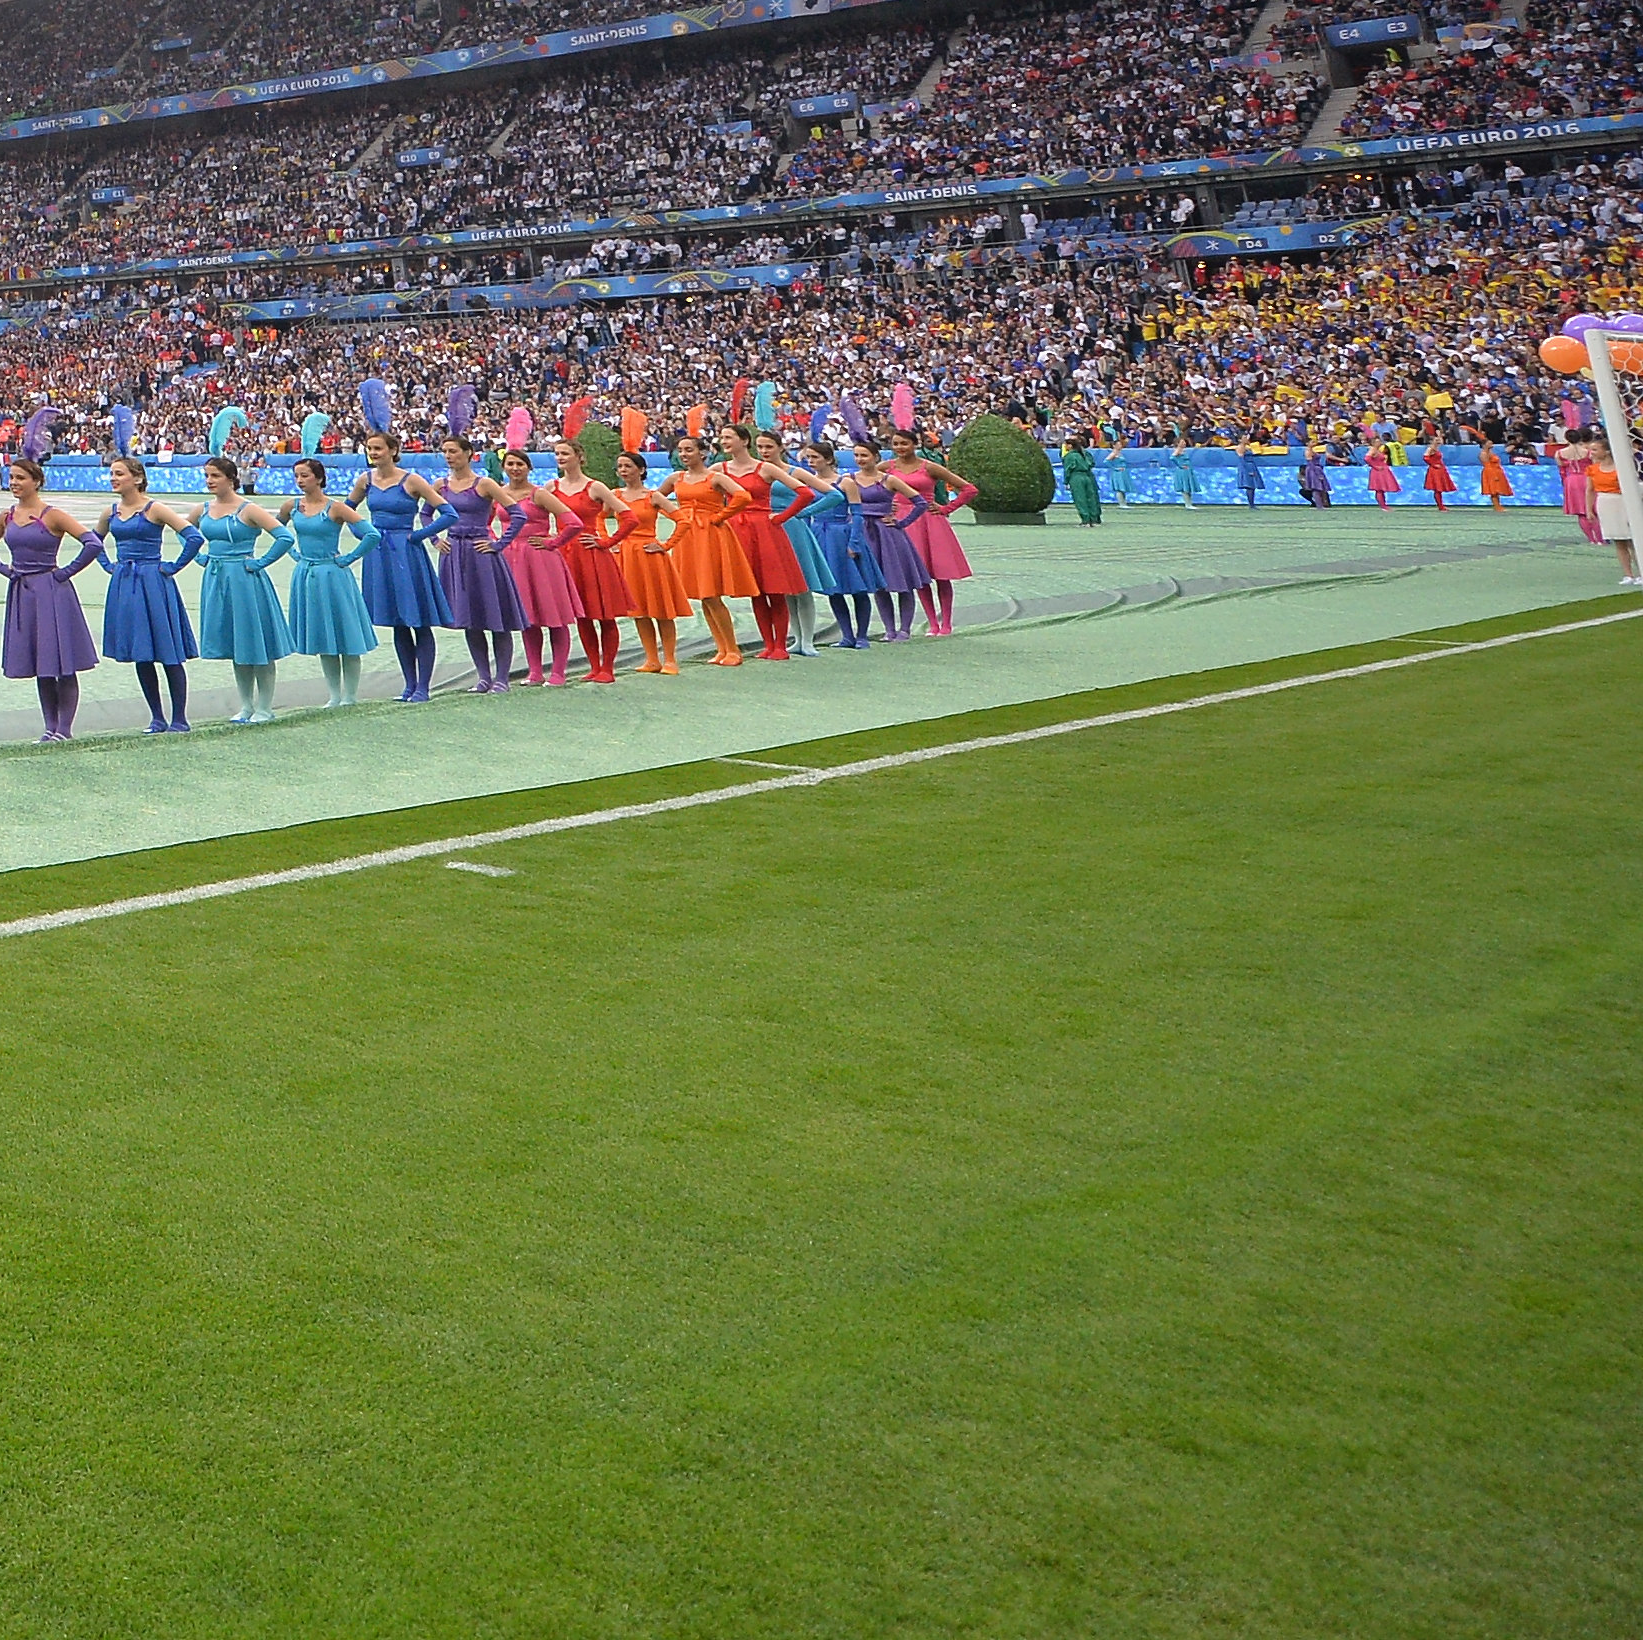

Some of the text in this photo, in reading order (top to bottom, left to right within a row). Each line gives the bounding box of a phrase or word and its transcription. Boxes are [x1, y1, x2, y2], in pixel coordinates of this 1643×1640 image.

[1387, 22, 1407, 33] E3
[570, 24, 647, 46] SAINT-DENIS
[1339, 29, 1360, 40] E4
[260, 73, 350, 96] UEFA EURO 2016
[799, 102, 814, 112] E6
[833, 98, 849, 108] E5
[1396, 122, 1581, 152] UEFA EURO 2016
[884, 185, 977, 203] SAINT-DENIS
[471, 224, 572, 241] UEFA EURO 2016
[1245, 240, 1263, 249] D4
[1318, 235, 1337, 244] D2
[178, 255, 233, 267] SAINT-DENIS
